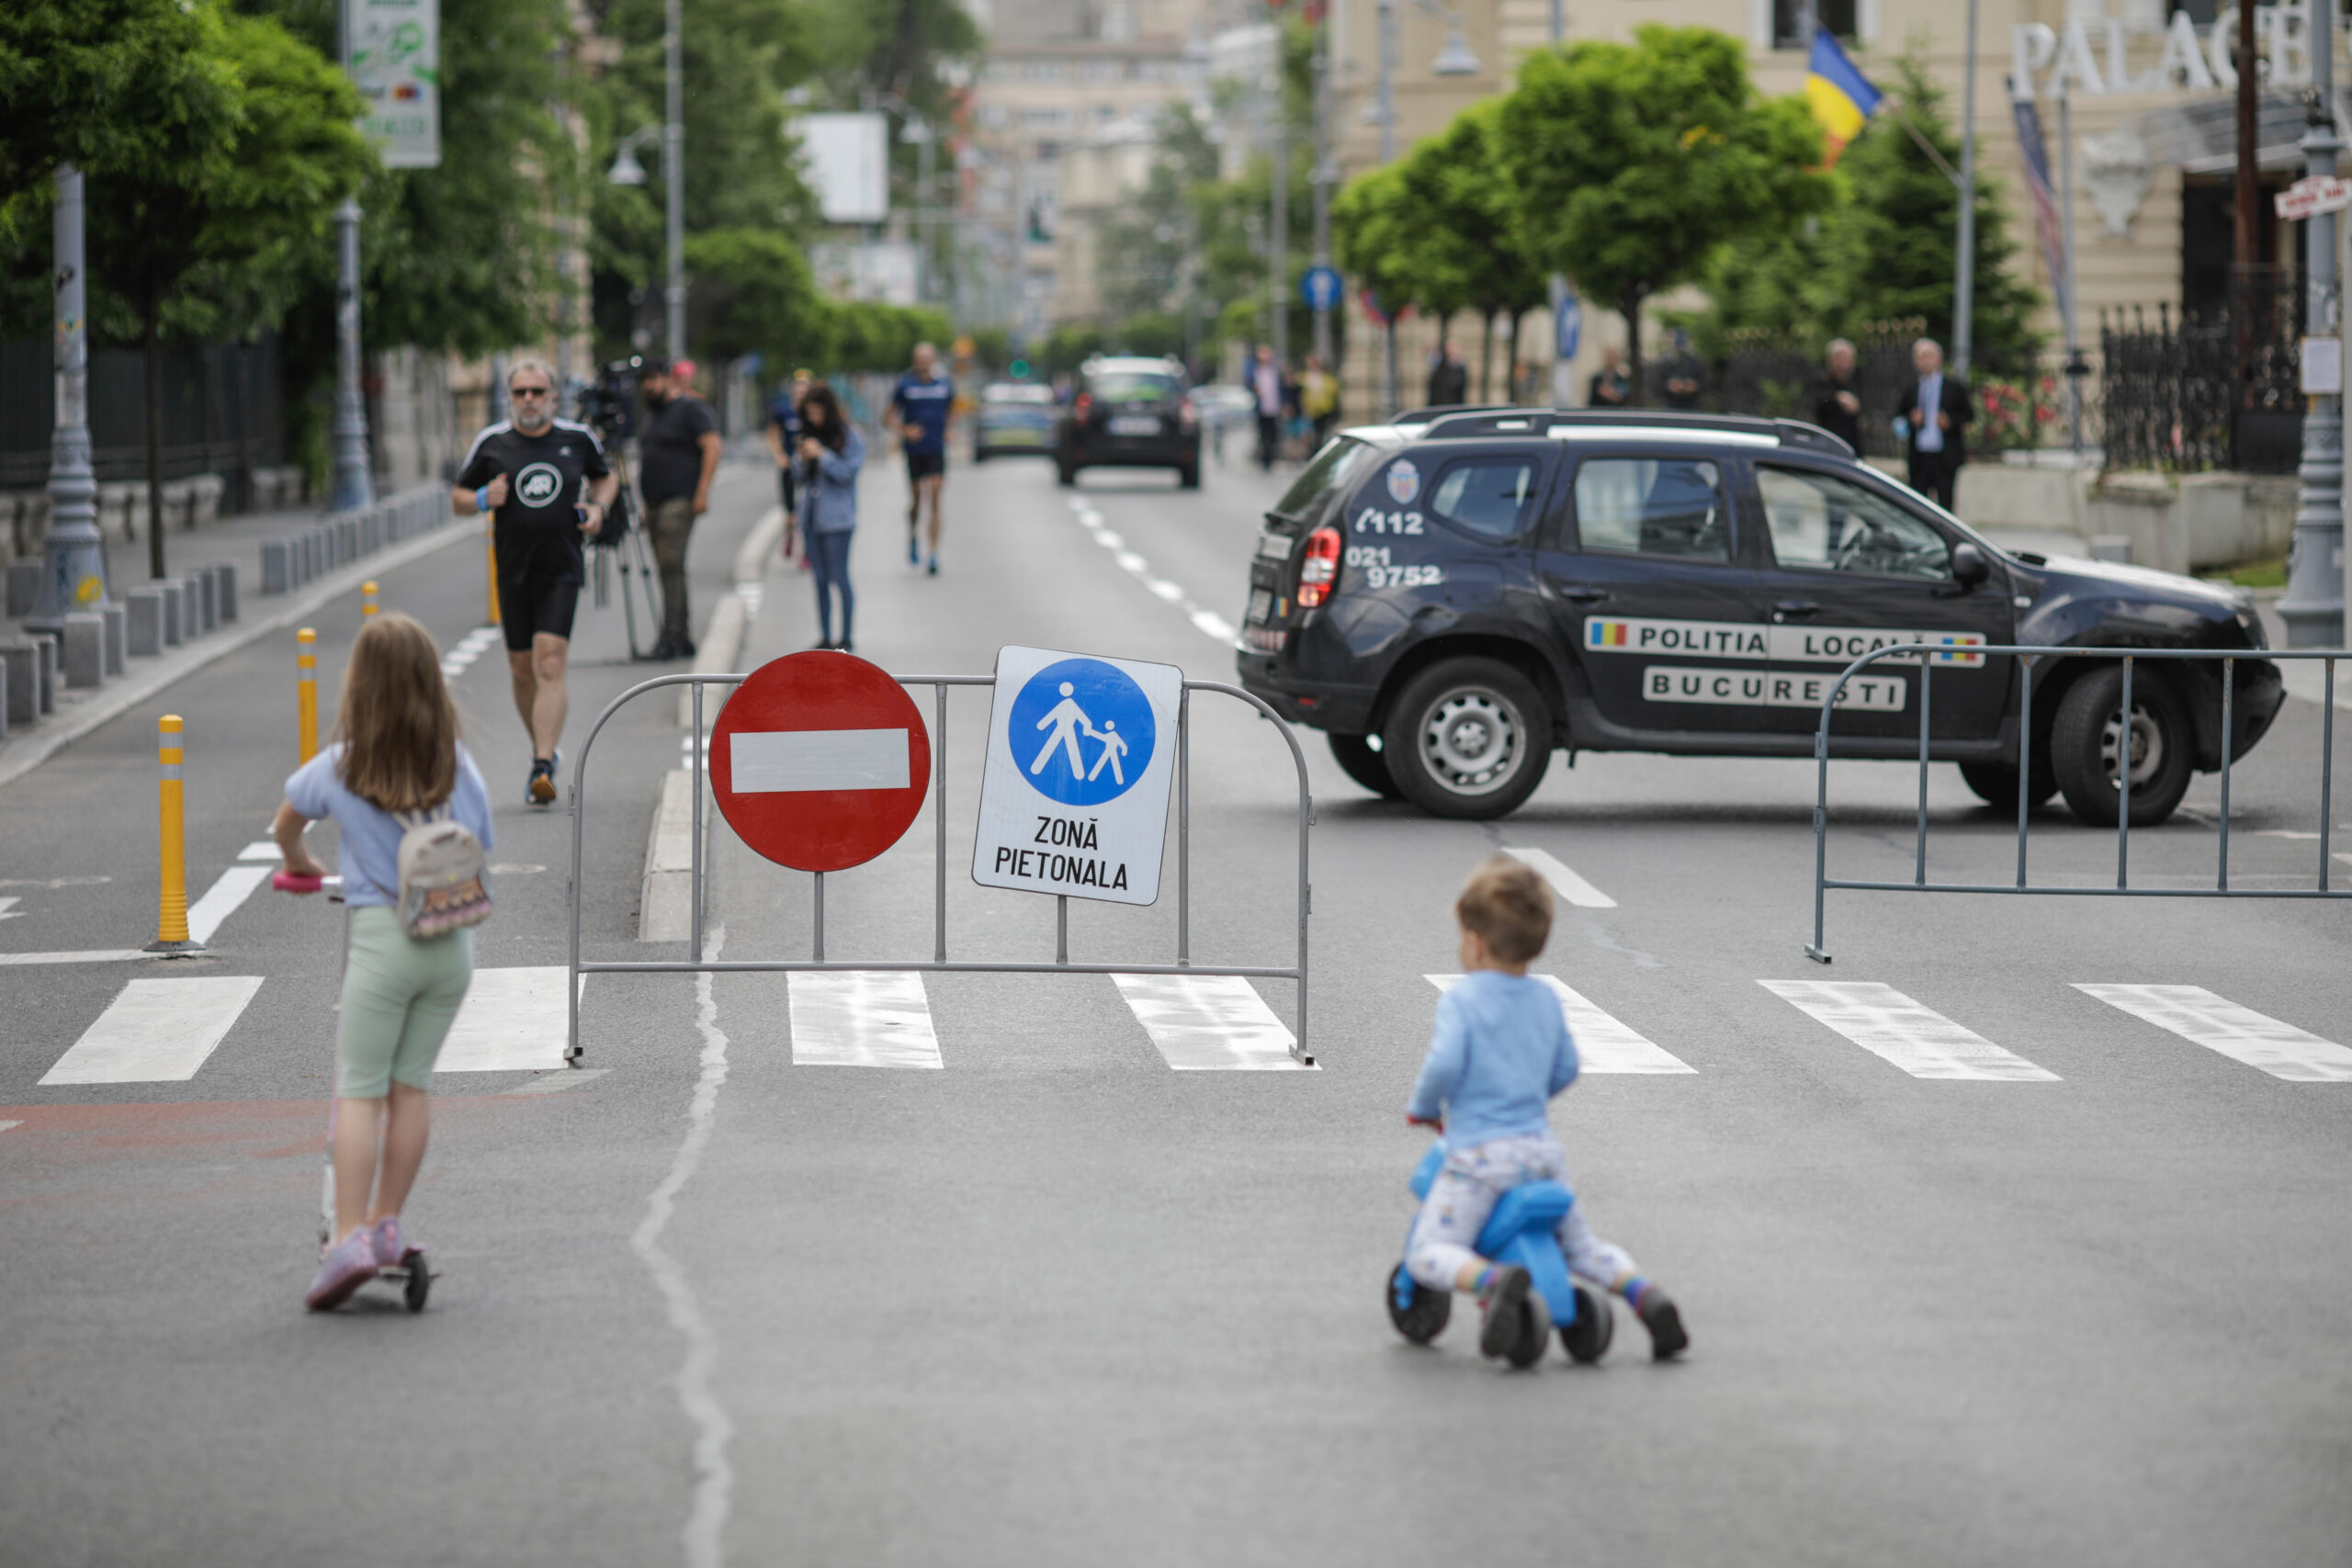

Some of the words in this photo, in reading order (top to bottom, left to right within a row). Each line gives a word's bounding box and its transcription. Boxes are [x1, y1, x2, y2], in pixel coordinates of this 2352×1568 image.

[1370, 511, 1423, 535] 112
[1345, 546, 1391, 568] 021
[1366, 564, 1442, 589] 9752
[1034, 816, 1099, 851] ZONĂ
[994, 846, 1128, 891] PIETONALA
